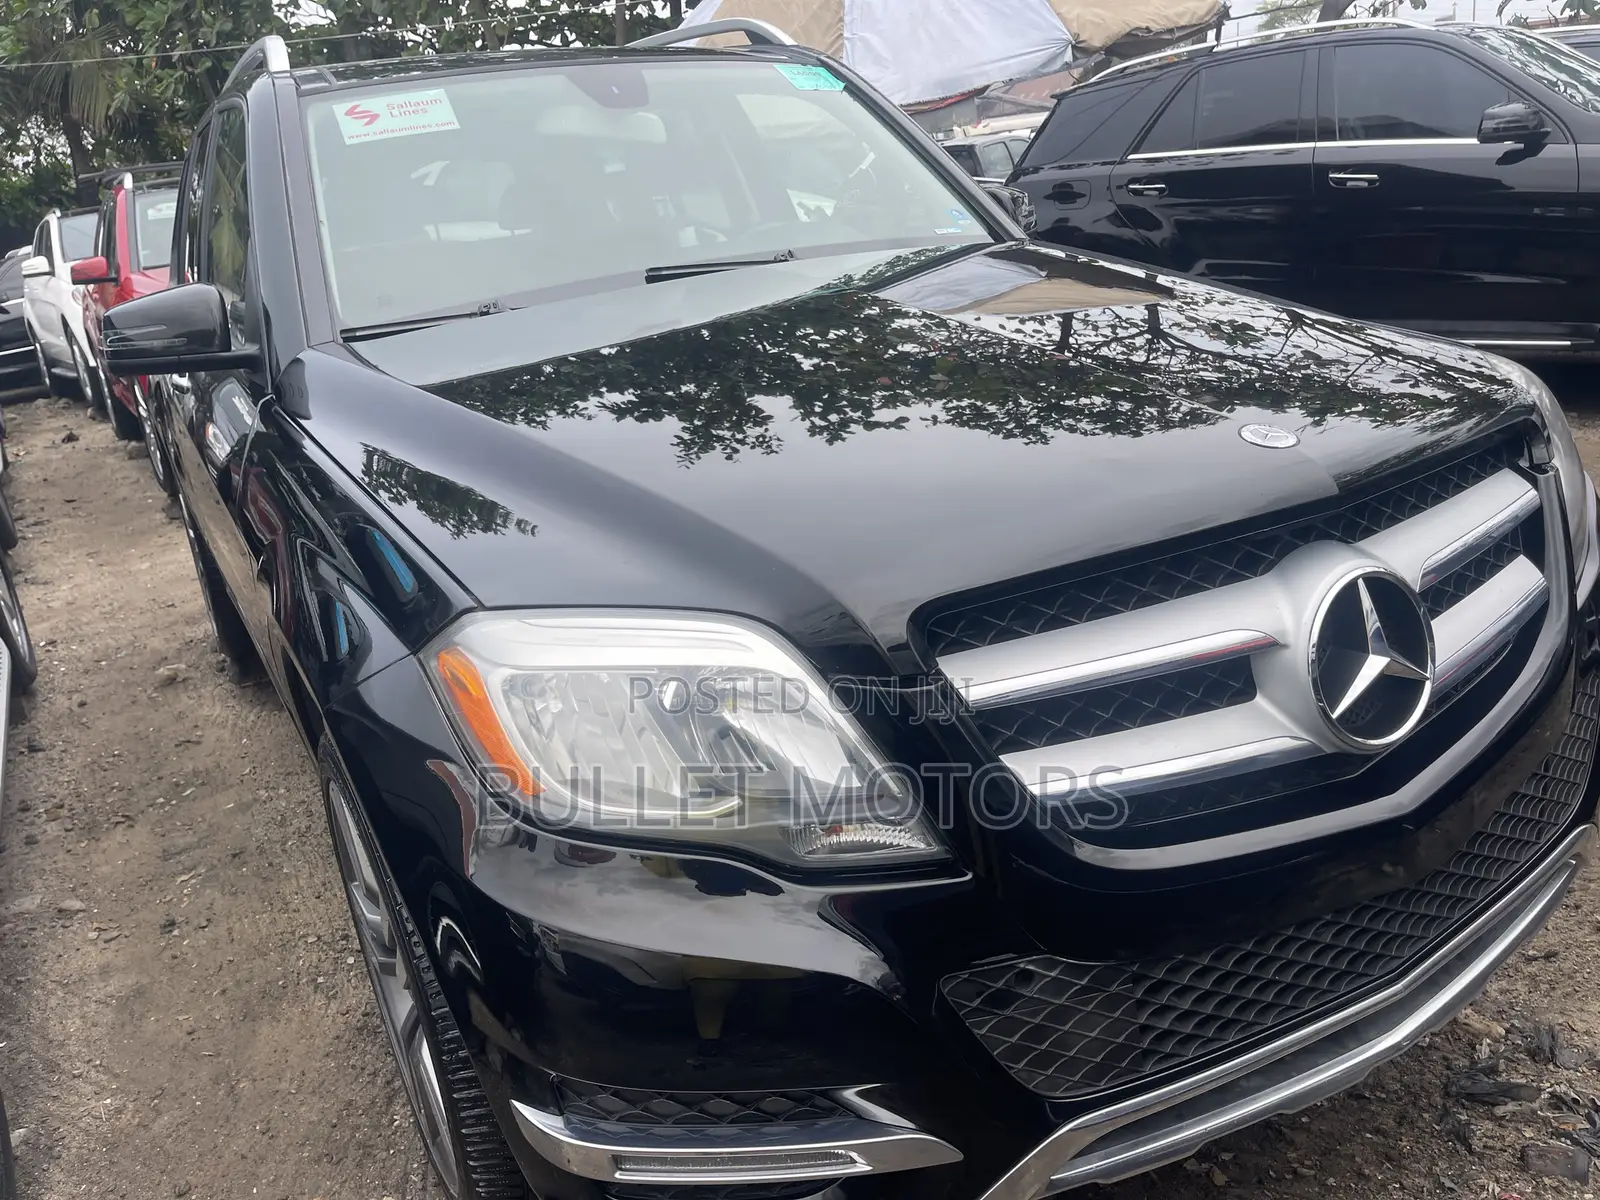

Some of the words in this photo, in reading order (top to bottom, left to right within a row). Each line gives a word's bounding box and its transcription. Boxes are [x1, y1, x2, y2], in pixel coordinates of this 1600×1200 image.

[386, 98, 442, 110] Sallaum
[389, 107, 428, 118] Lines
[347, 121, 455, 140] www.sallaumlines.com
